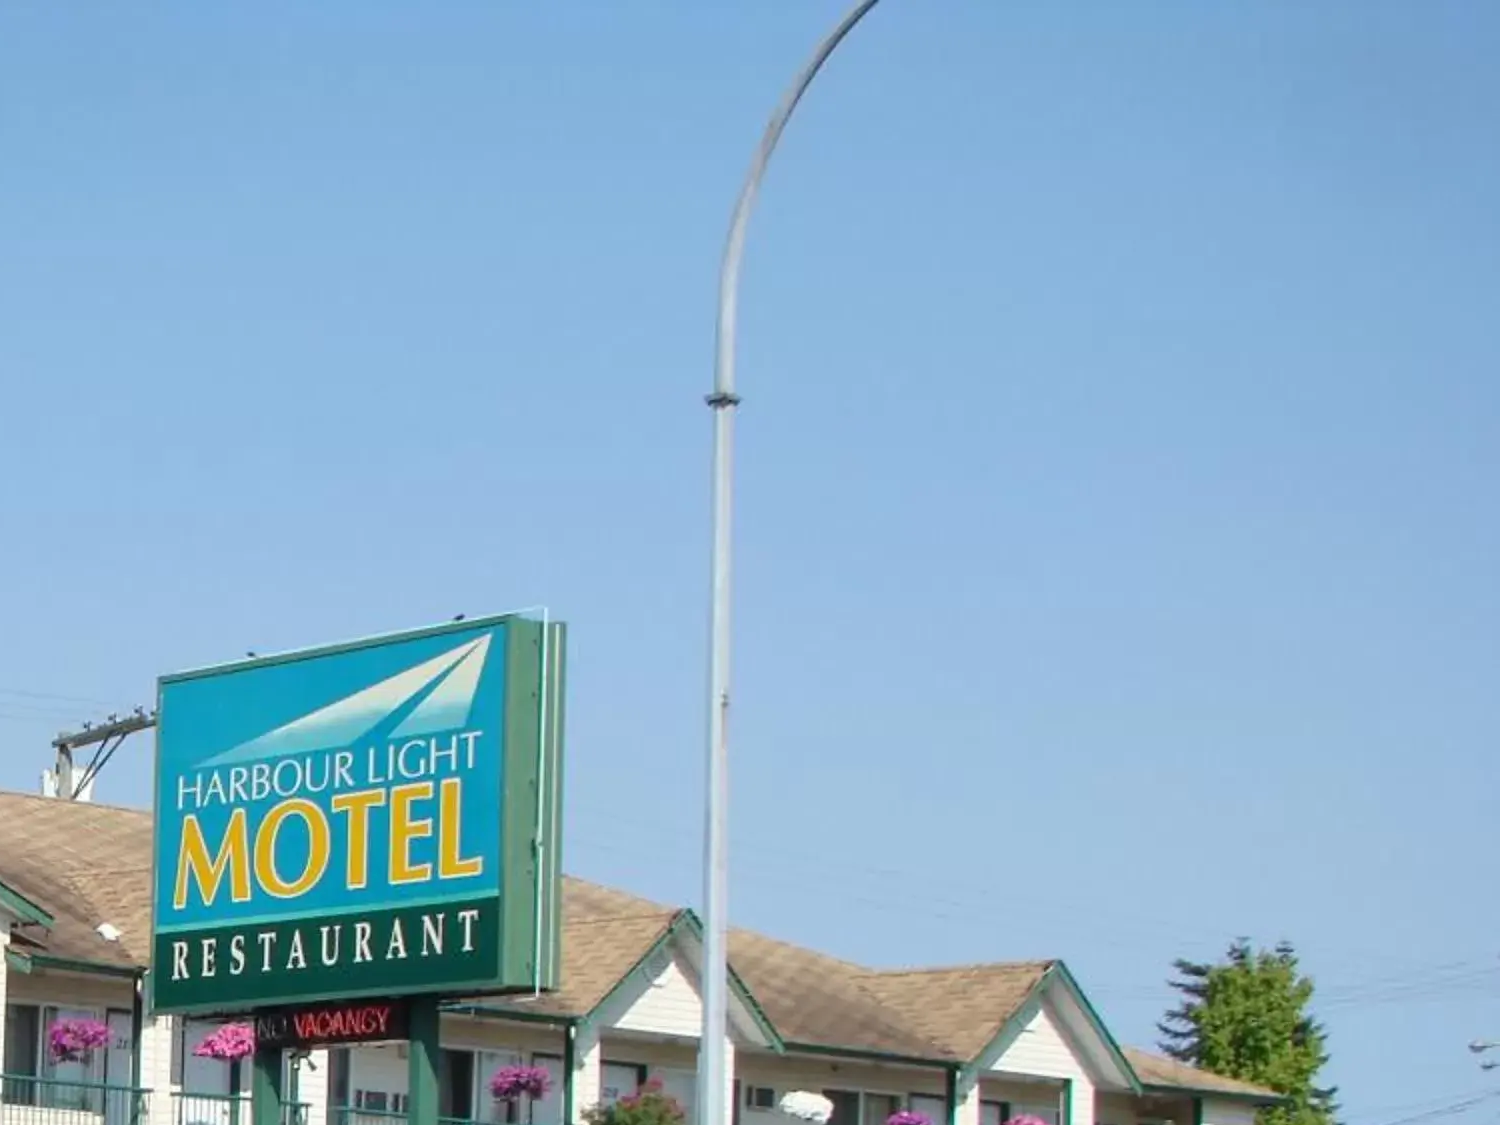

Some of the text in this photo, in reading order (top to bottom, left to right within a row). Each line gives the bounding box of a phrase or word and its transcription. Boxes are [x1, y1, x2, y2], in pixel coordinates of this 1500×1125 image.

[176, 730, 484, 811] HARBOUR LIGHT
[172, 776, 484, 910] MOTEL
[171, 909, 481, 982] RESTAURANT
